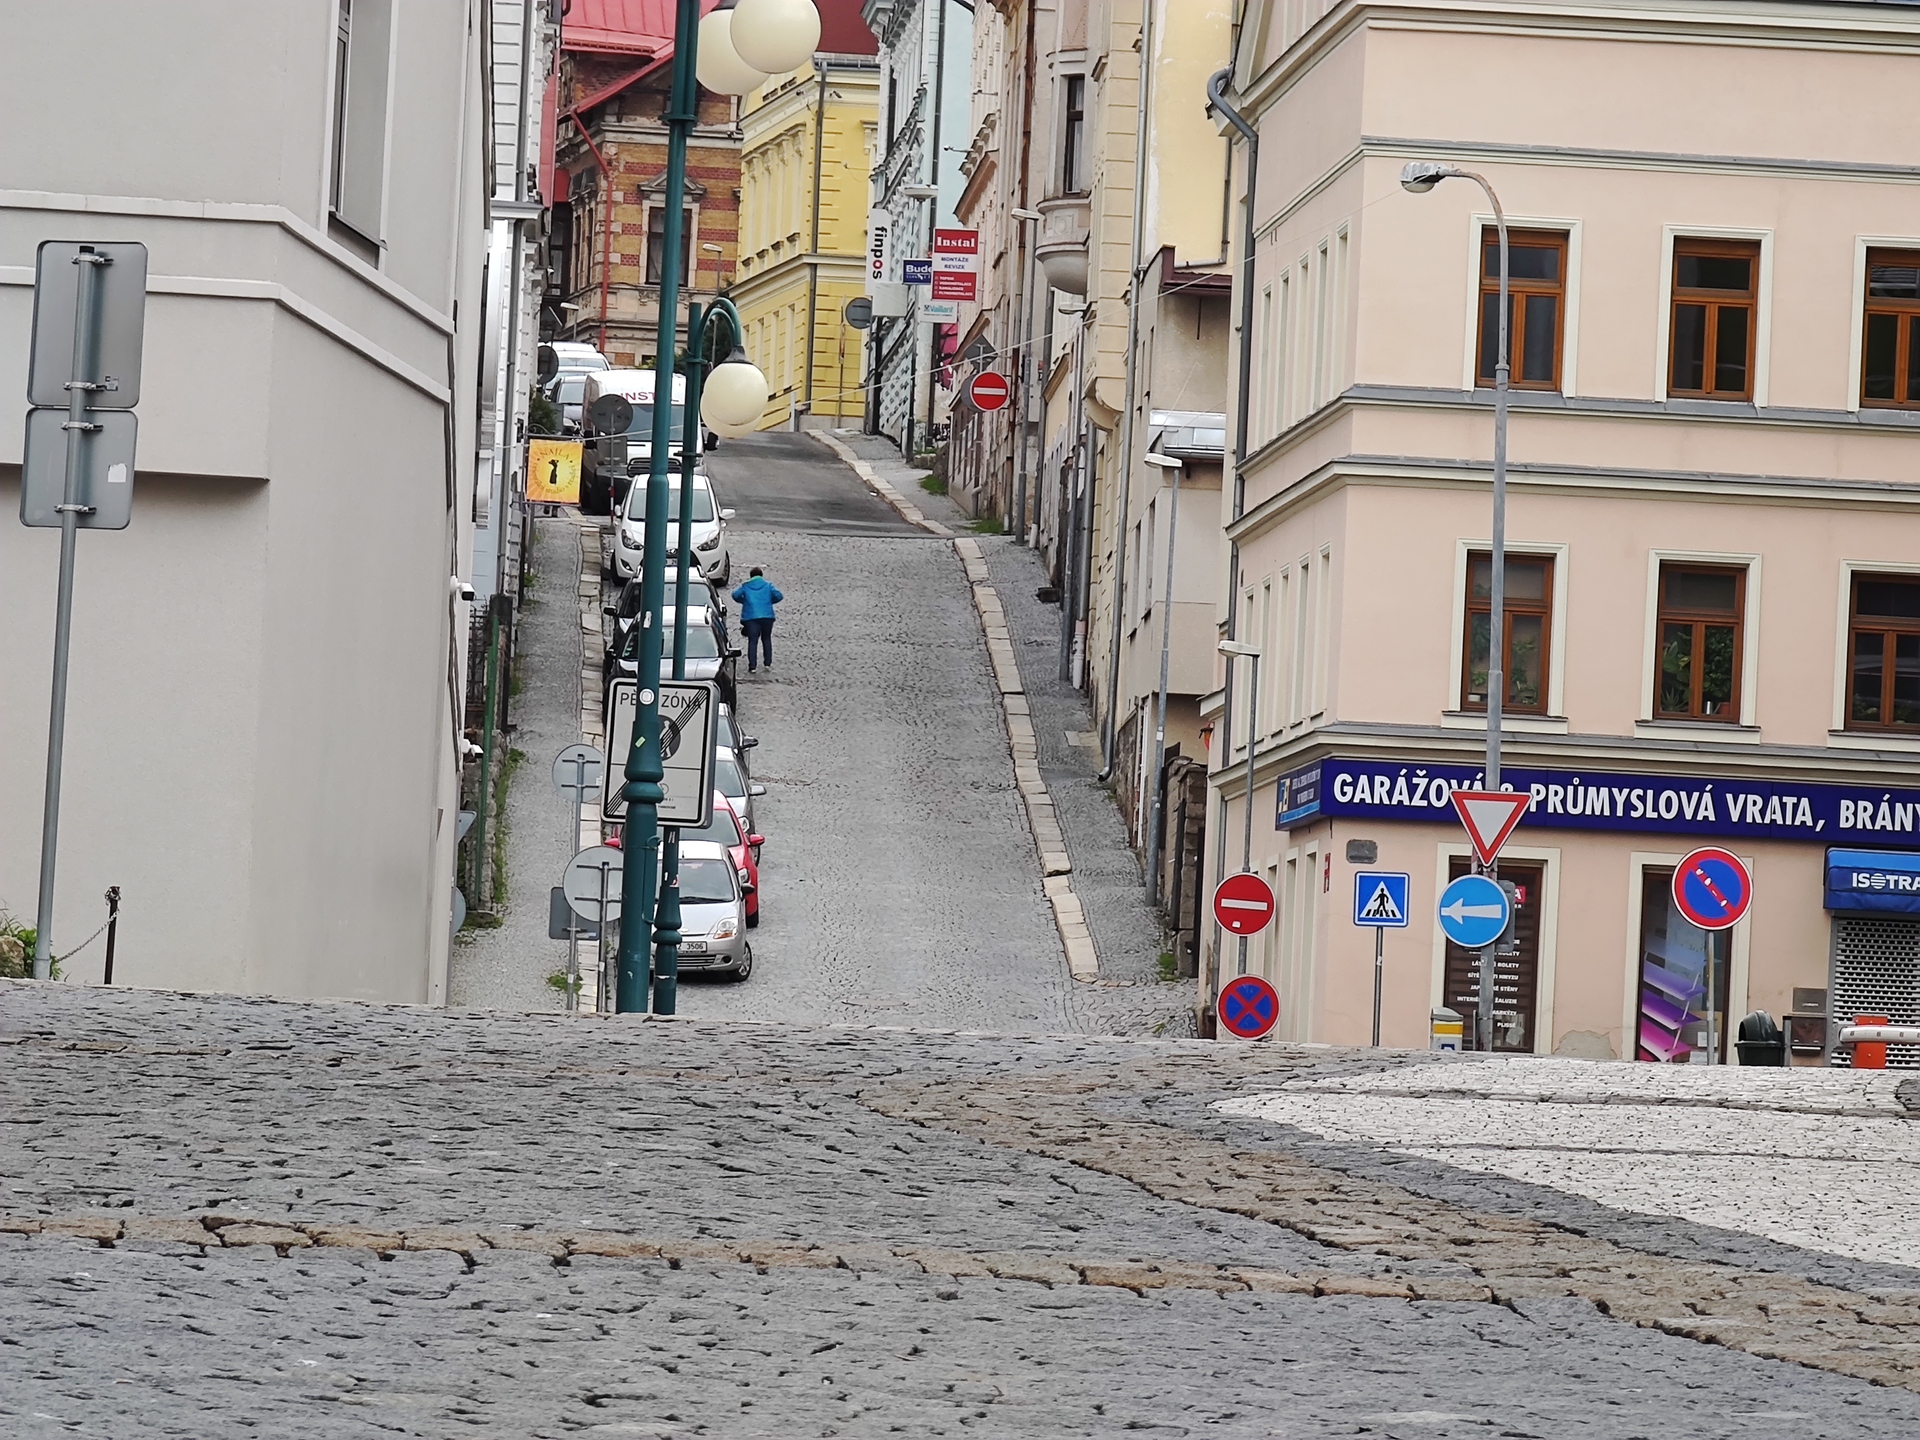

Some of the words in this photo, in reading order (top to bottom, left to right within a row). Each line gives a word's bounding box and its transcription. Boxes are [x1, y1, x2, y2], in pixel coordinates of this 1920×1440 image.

[871, 226, 887, 279] finpos
[937, 236, 975, 248] Instal
[620, 689, 637, 706] PĚ
[1529, 777, 1716, 821] PRŮMYSLOVÁ
[1726, 793, 1825, 832] VRATA,
